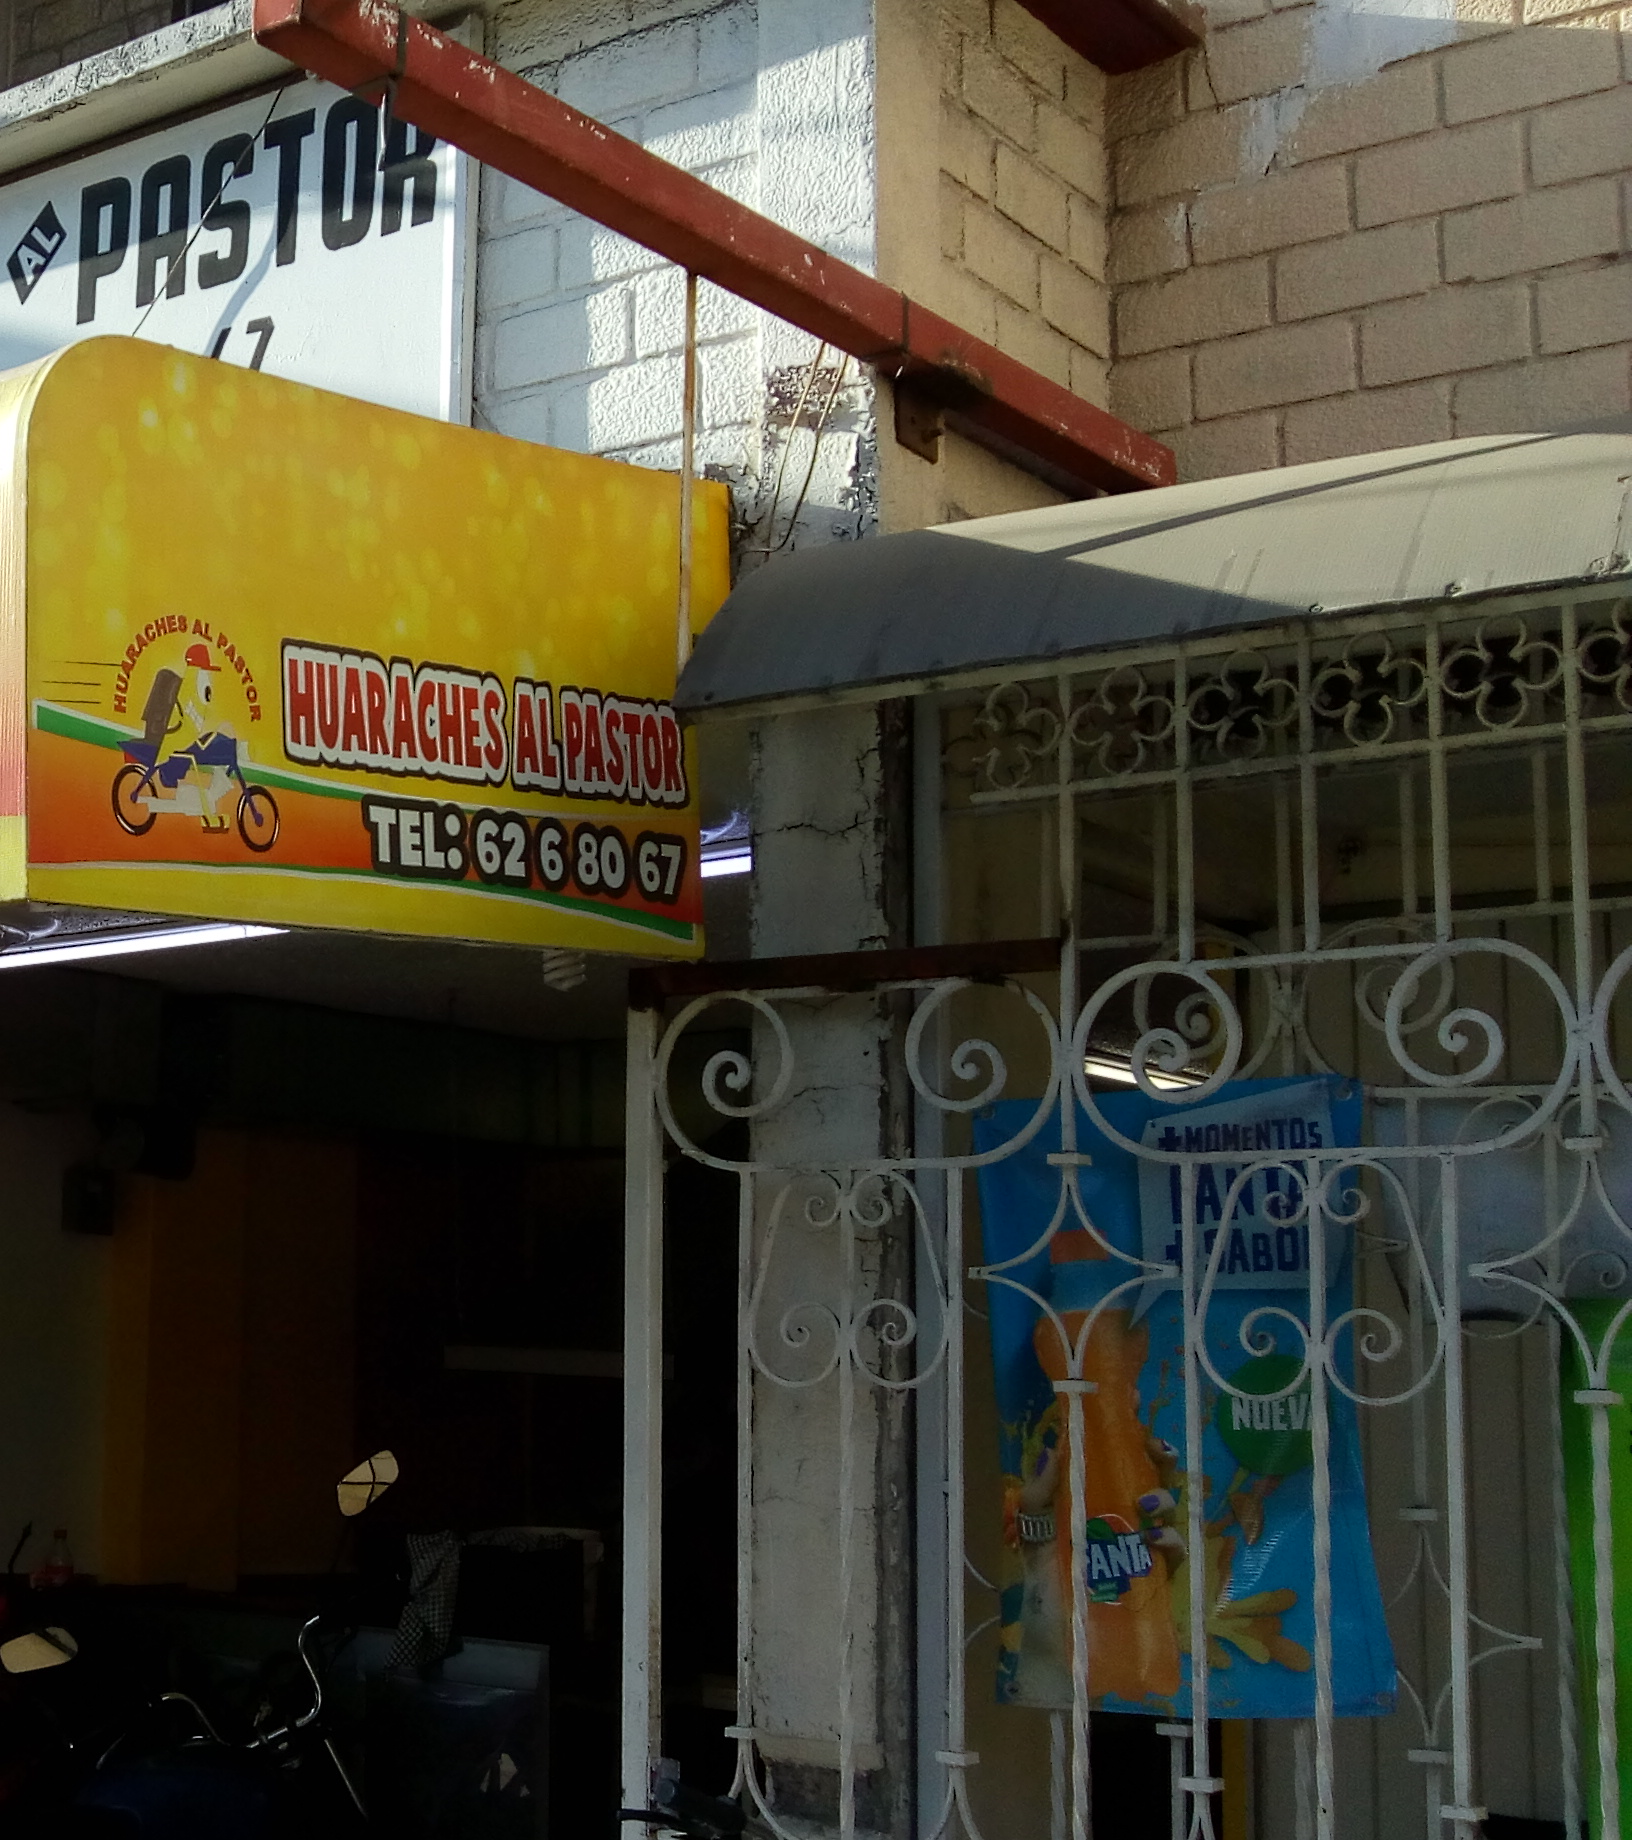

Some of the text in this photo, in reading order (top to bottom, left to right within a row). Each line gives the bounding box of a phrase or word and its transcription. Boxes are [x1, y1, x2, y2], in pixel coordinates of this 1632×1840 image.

[18, 226, 61, 286] AL
[76, 95, 439, 325] PASTOR
[114, 614, 262, 723] HUARACHES AL PASTOR
[287, 656, 683, 792] HUARACHES AL PASTOR
[367, 805, 683, 896] TEL: 62 6 80 67
[1231, 1396, 1312, 1432] NUEV
[1086, 1534, 1153, 1580] ANTA
